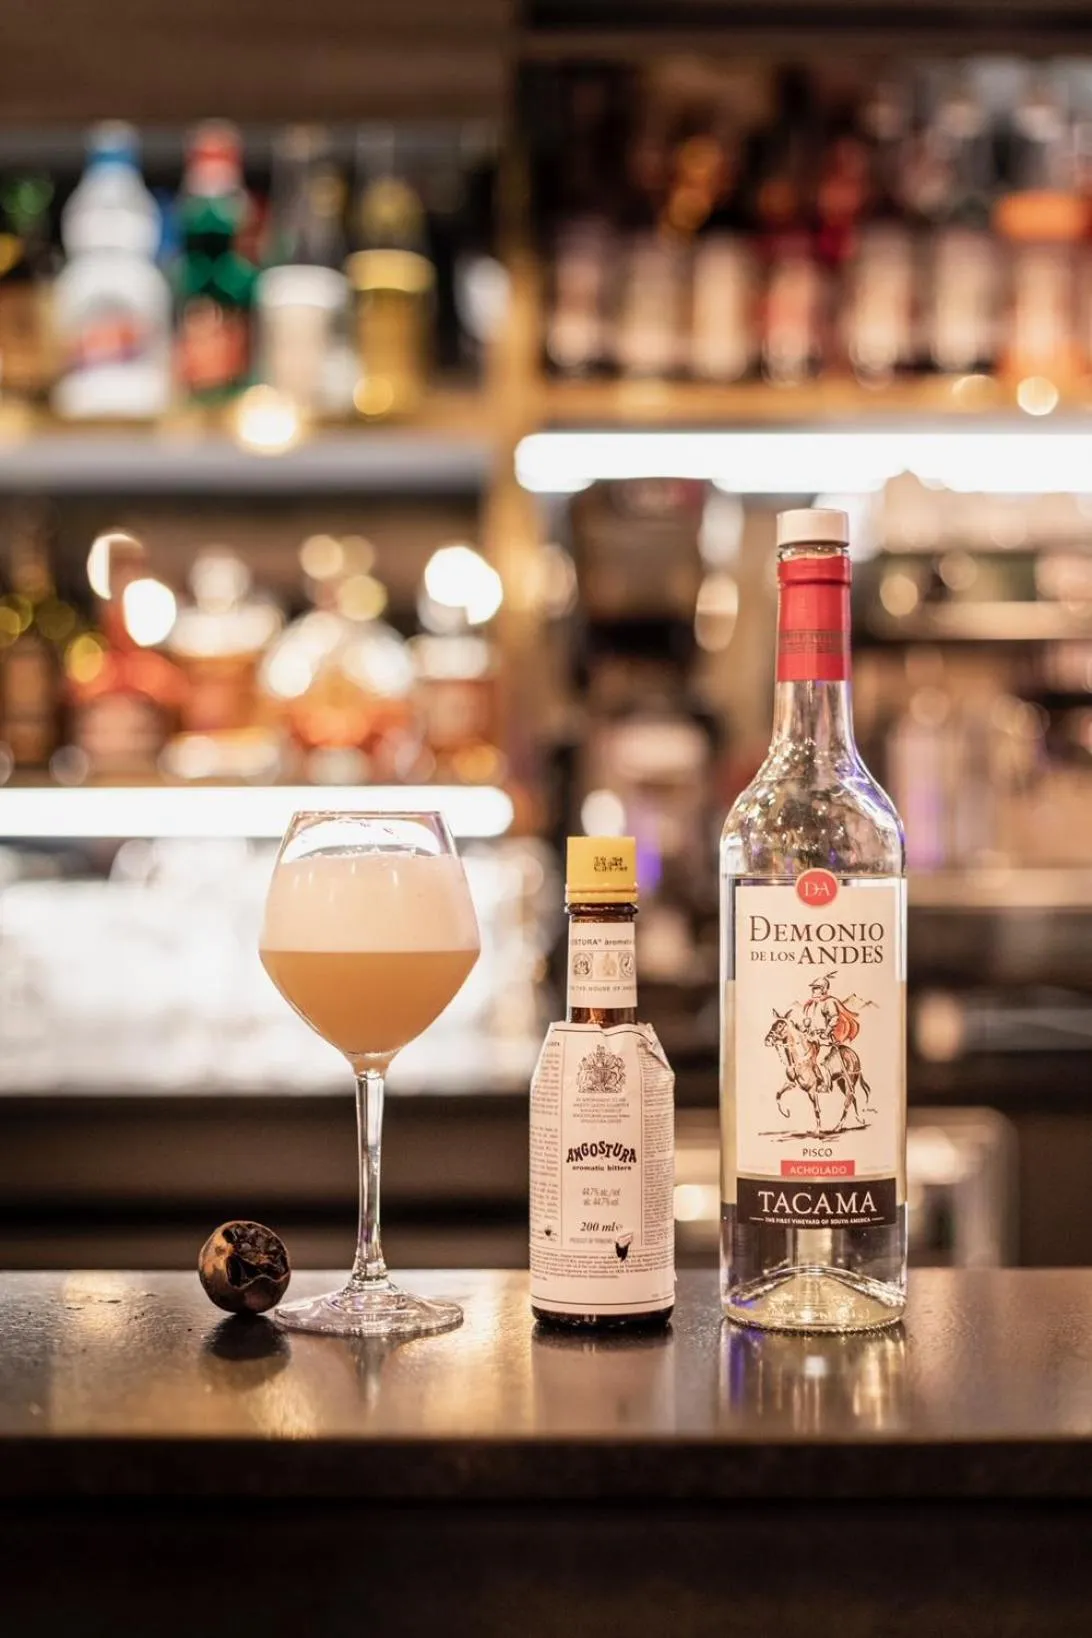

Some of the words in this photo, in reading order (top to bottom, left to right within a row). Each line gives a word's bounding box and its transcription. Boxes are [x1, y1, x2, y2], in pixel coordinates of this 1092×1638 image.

[749, 915, 884, 942] DEMONIO
[751, 951, 767, 962] DE
[770, 951, 796, 962] LOS
[797, 945, 884, 965] ANDES
[566, 1141, 637, 1163] ANGOSTURA
[802, 1148, 833, 1158] PISCO
[789, 1165, 848, 1175] ACHOLADO
[758, 1191, 877, 1215] TACAMA
[580, 1221, 599, 1232] 200
